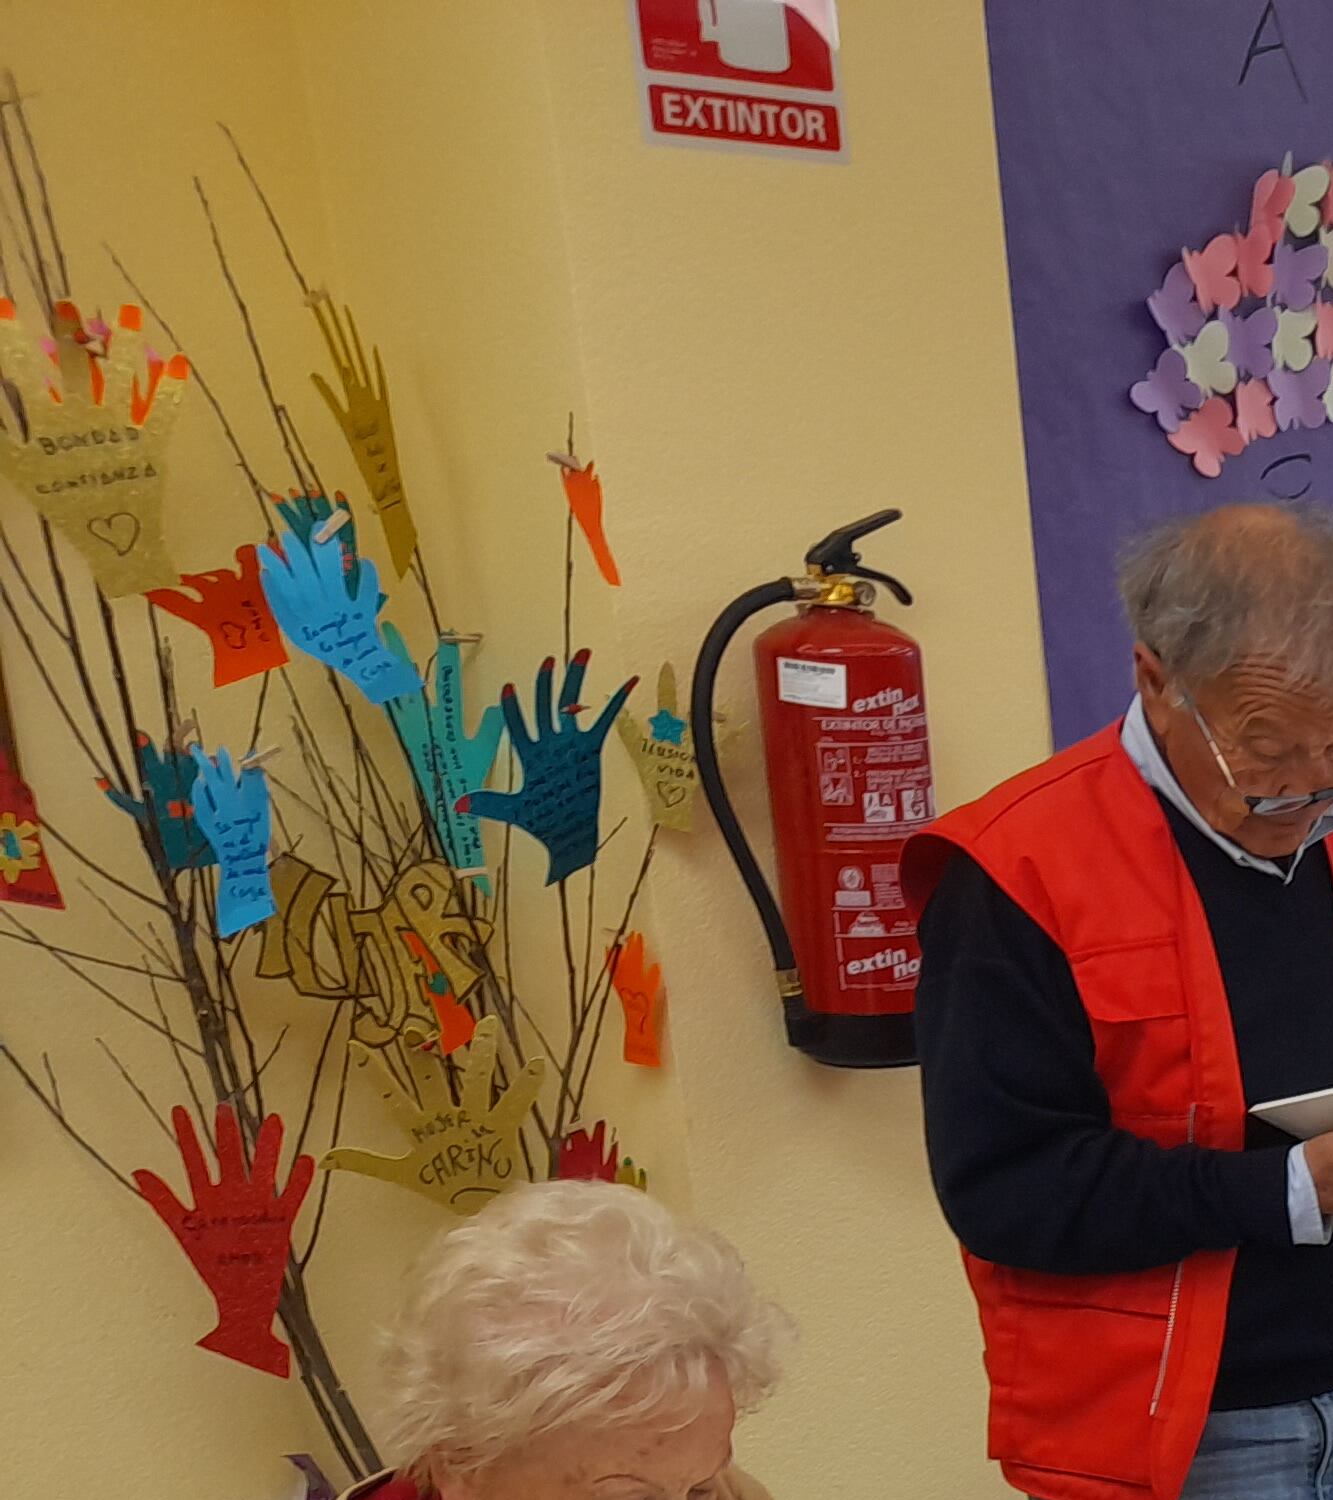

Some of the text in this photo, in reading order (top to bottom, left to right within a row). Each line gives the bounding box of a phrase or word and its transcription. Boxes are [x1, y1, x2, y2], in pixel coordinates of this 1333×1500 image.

[1239, 0, 1307, 101] A
[661, 92, 827, 143] EXTINTOR
[640, 738, 698, 764] ILUSIO
